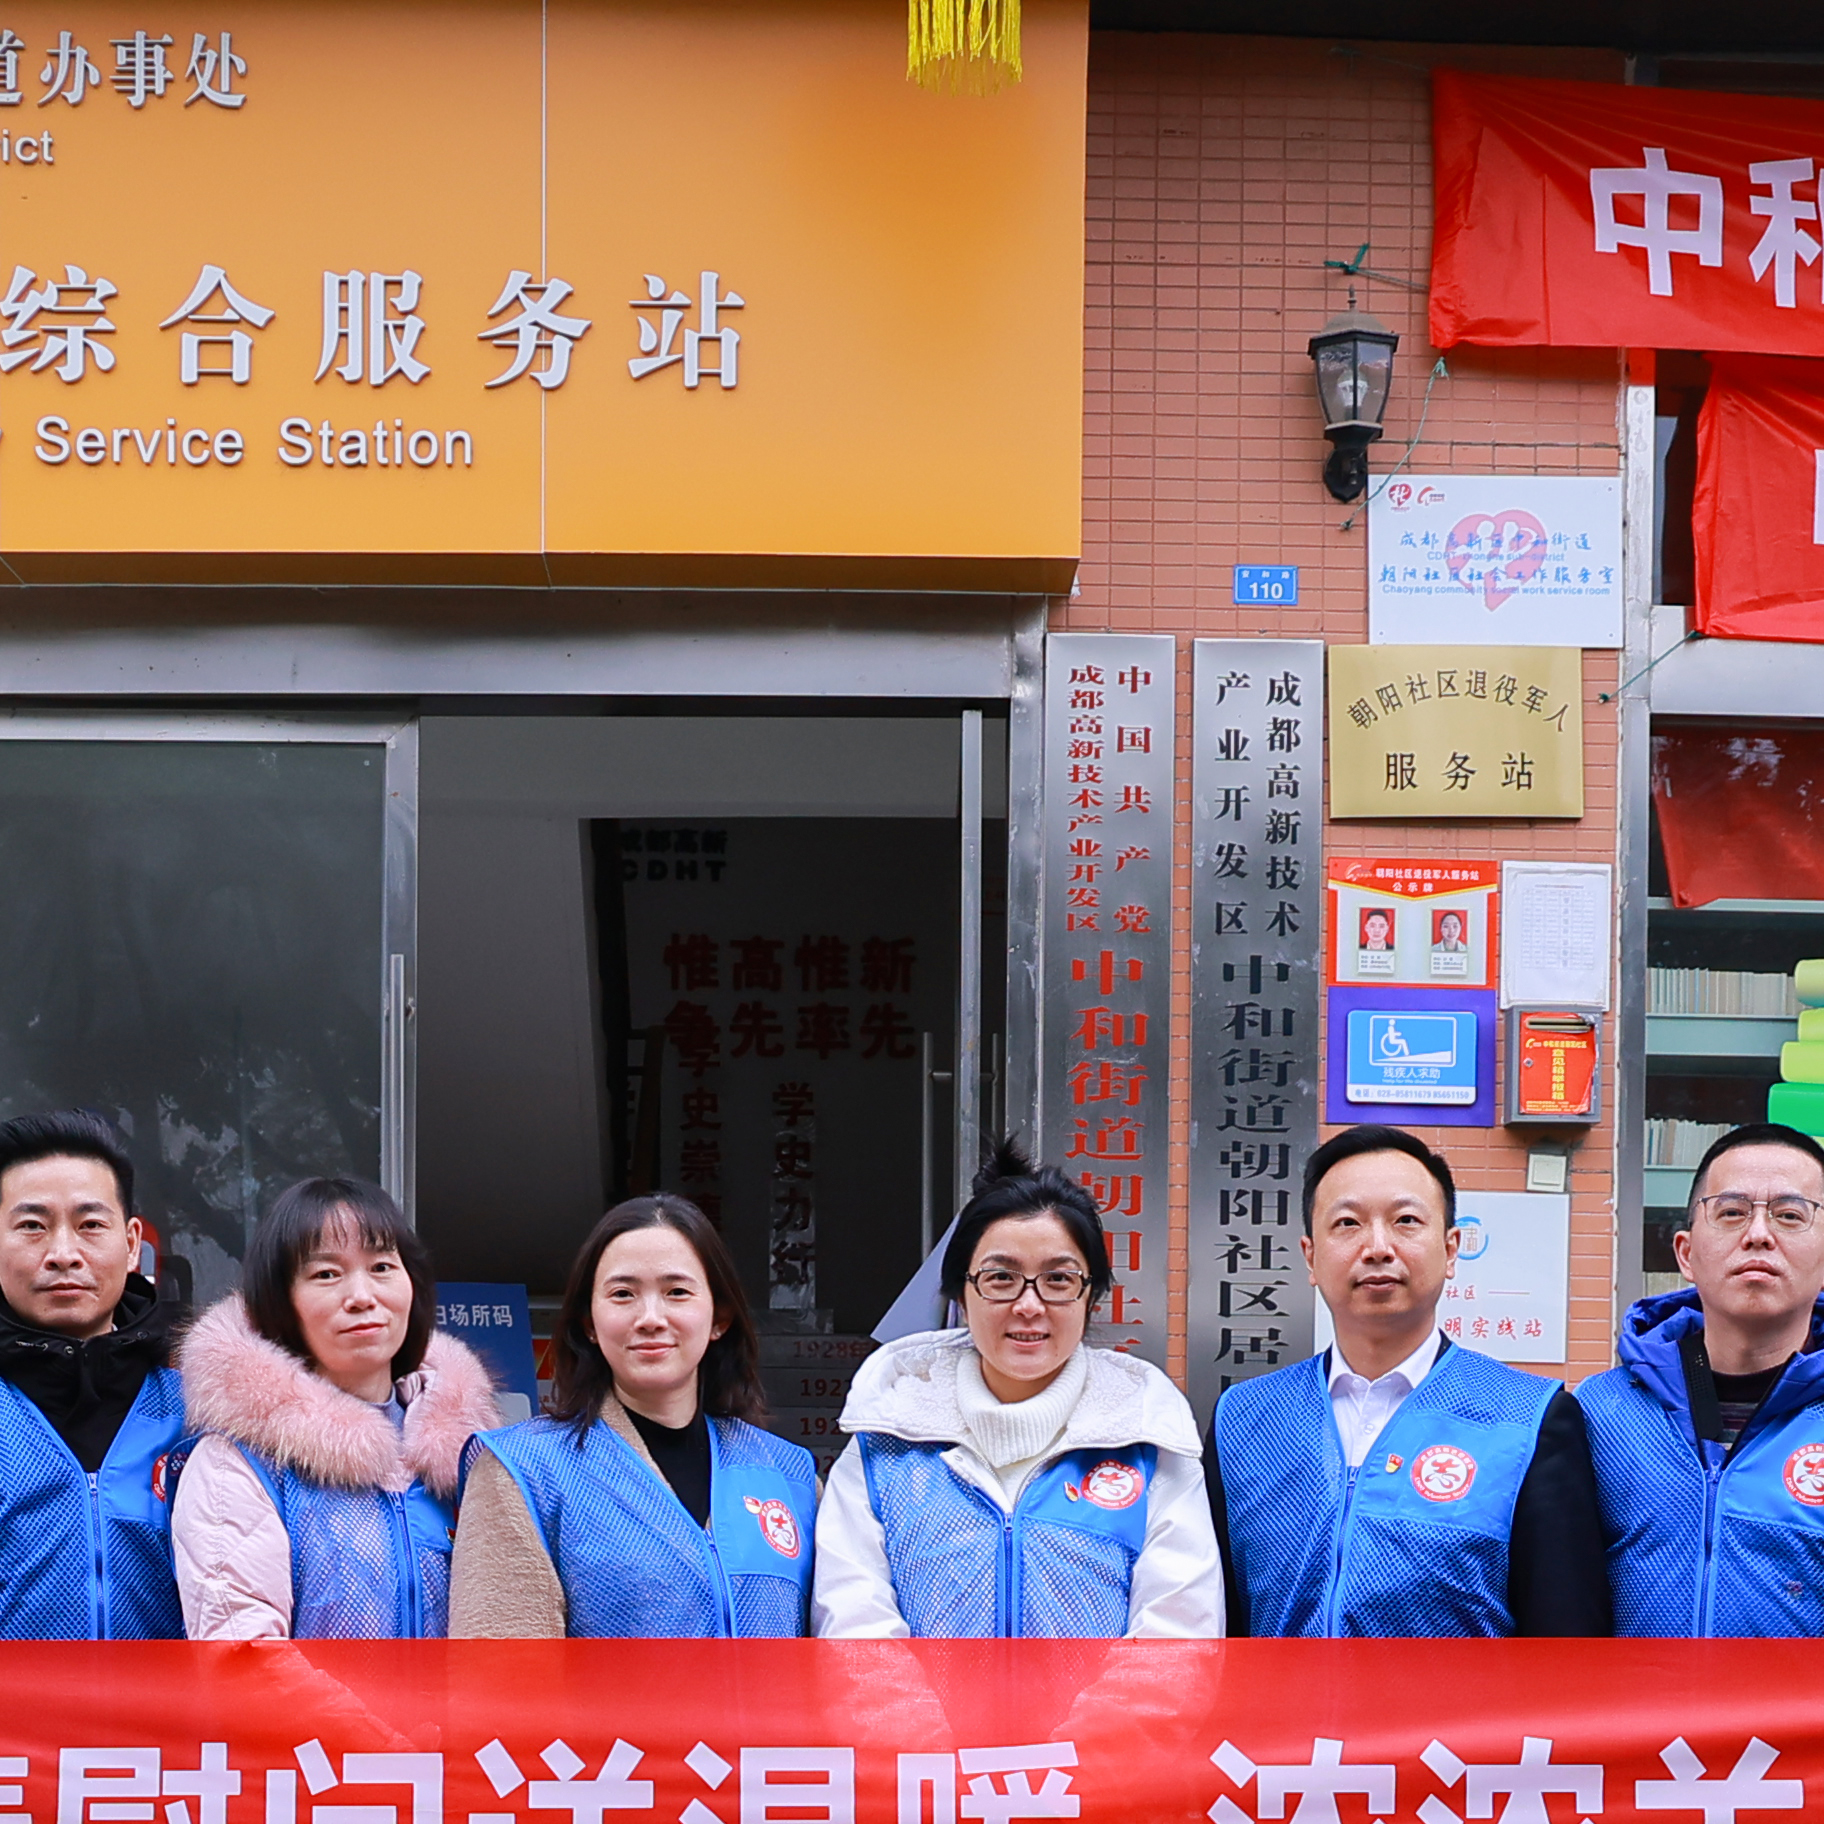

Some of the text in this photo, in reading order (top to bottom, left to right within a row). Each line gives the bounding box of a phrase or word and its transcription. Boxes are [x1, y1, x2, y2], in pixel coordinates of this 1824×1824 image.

[34, 414, 245, 465] Service
[278, 415, 474, 467] Station
[1249, 582, 1283, 599] 110
[1346, 668, 1572, 733] 朝阳社区退役军人
[1066, 664, 1105, 932] 成都高新技术产业开发区
[1113, 665, 1152, 933] 中国共产党
[1214, 671, 1251, 936] 产业开发区
[1265, 671, 1302, 937] 成都高新技术
[1384, 751, 1536, 792] 服务站
[663, 933, 917, 993] 惟高惟新
[663, 1000, 917, 1060] 争先率先
[1065, 950, 1149, 1352] 中和街道朝
[1214, 954, 1296, 1392] 中和街道朝阳社区居
[1445, 1285, 1475, 1300] 社区
